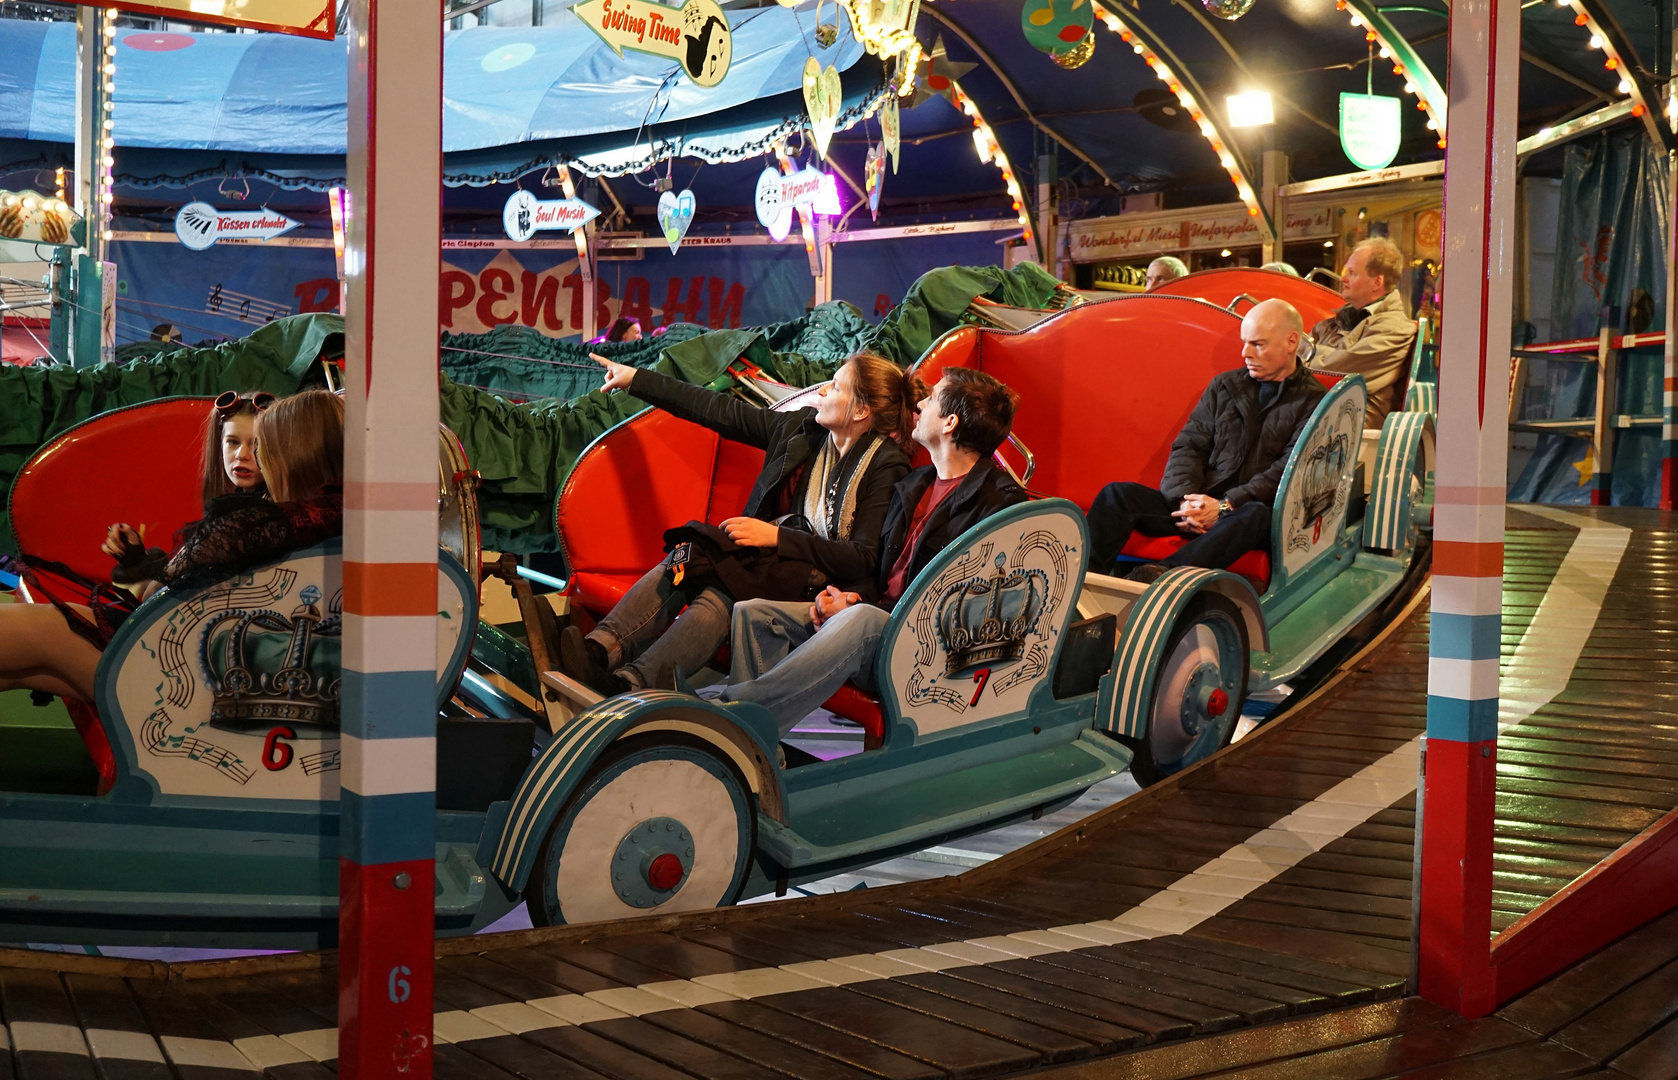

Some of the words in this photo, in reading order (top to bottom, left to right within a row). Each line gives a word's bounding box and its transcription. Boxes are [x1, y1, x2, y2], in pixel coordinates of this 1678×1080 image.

[602, 0, 646, 43] Swing
[649, 12, 681, 46] Time
[781, 176, 820, 203] Hitparade
[216, 216, 250, 232] Küssen
[535, 205, 556, 223] Soul
[556, 204, 586, 222] Musik
[441, 239, 456, 248] ric
[457, 239, 495, 248] Clapton
[1079, 228, 1144, 249] Wonderful
[1145, 227, 1183, 243] Music
[1312, 515, 1323, 545] 8
[970, 668, 992, 707] 7
[261, 726, 296, 772] 6
[388, 965, 412, 1004] 6
